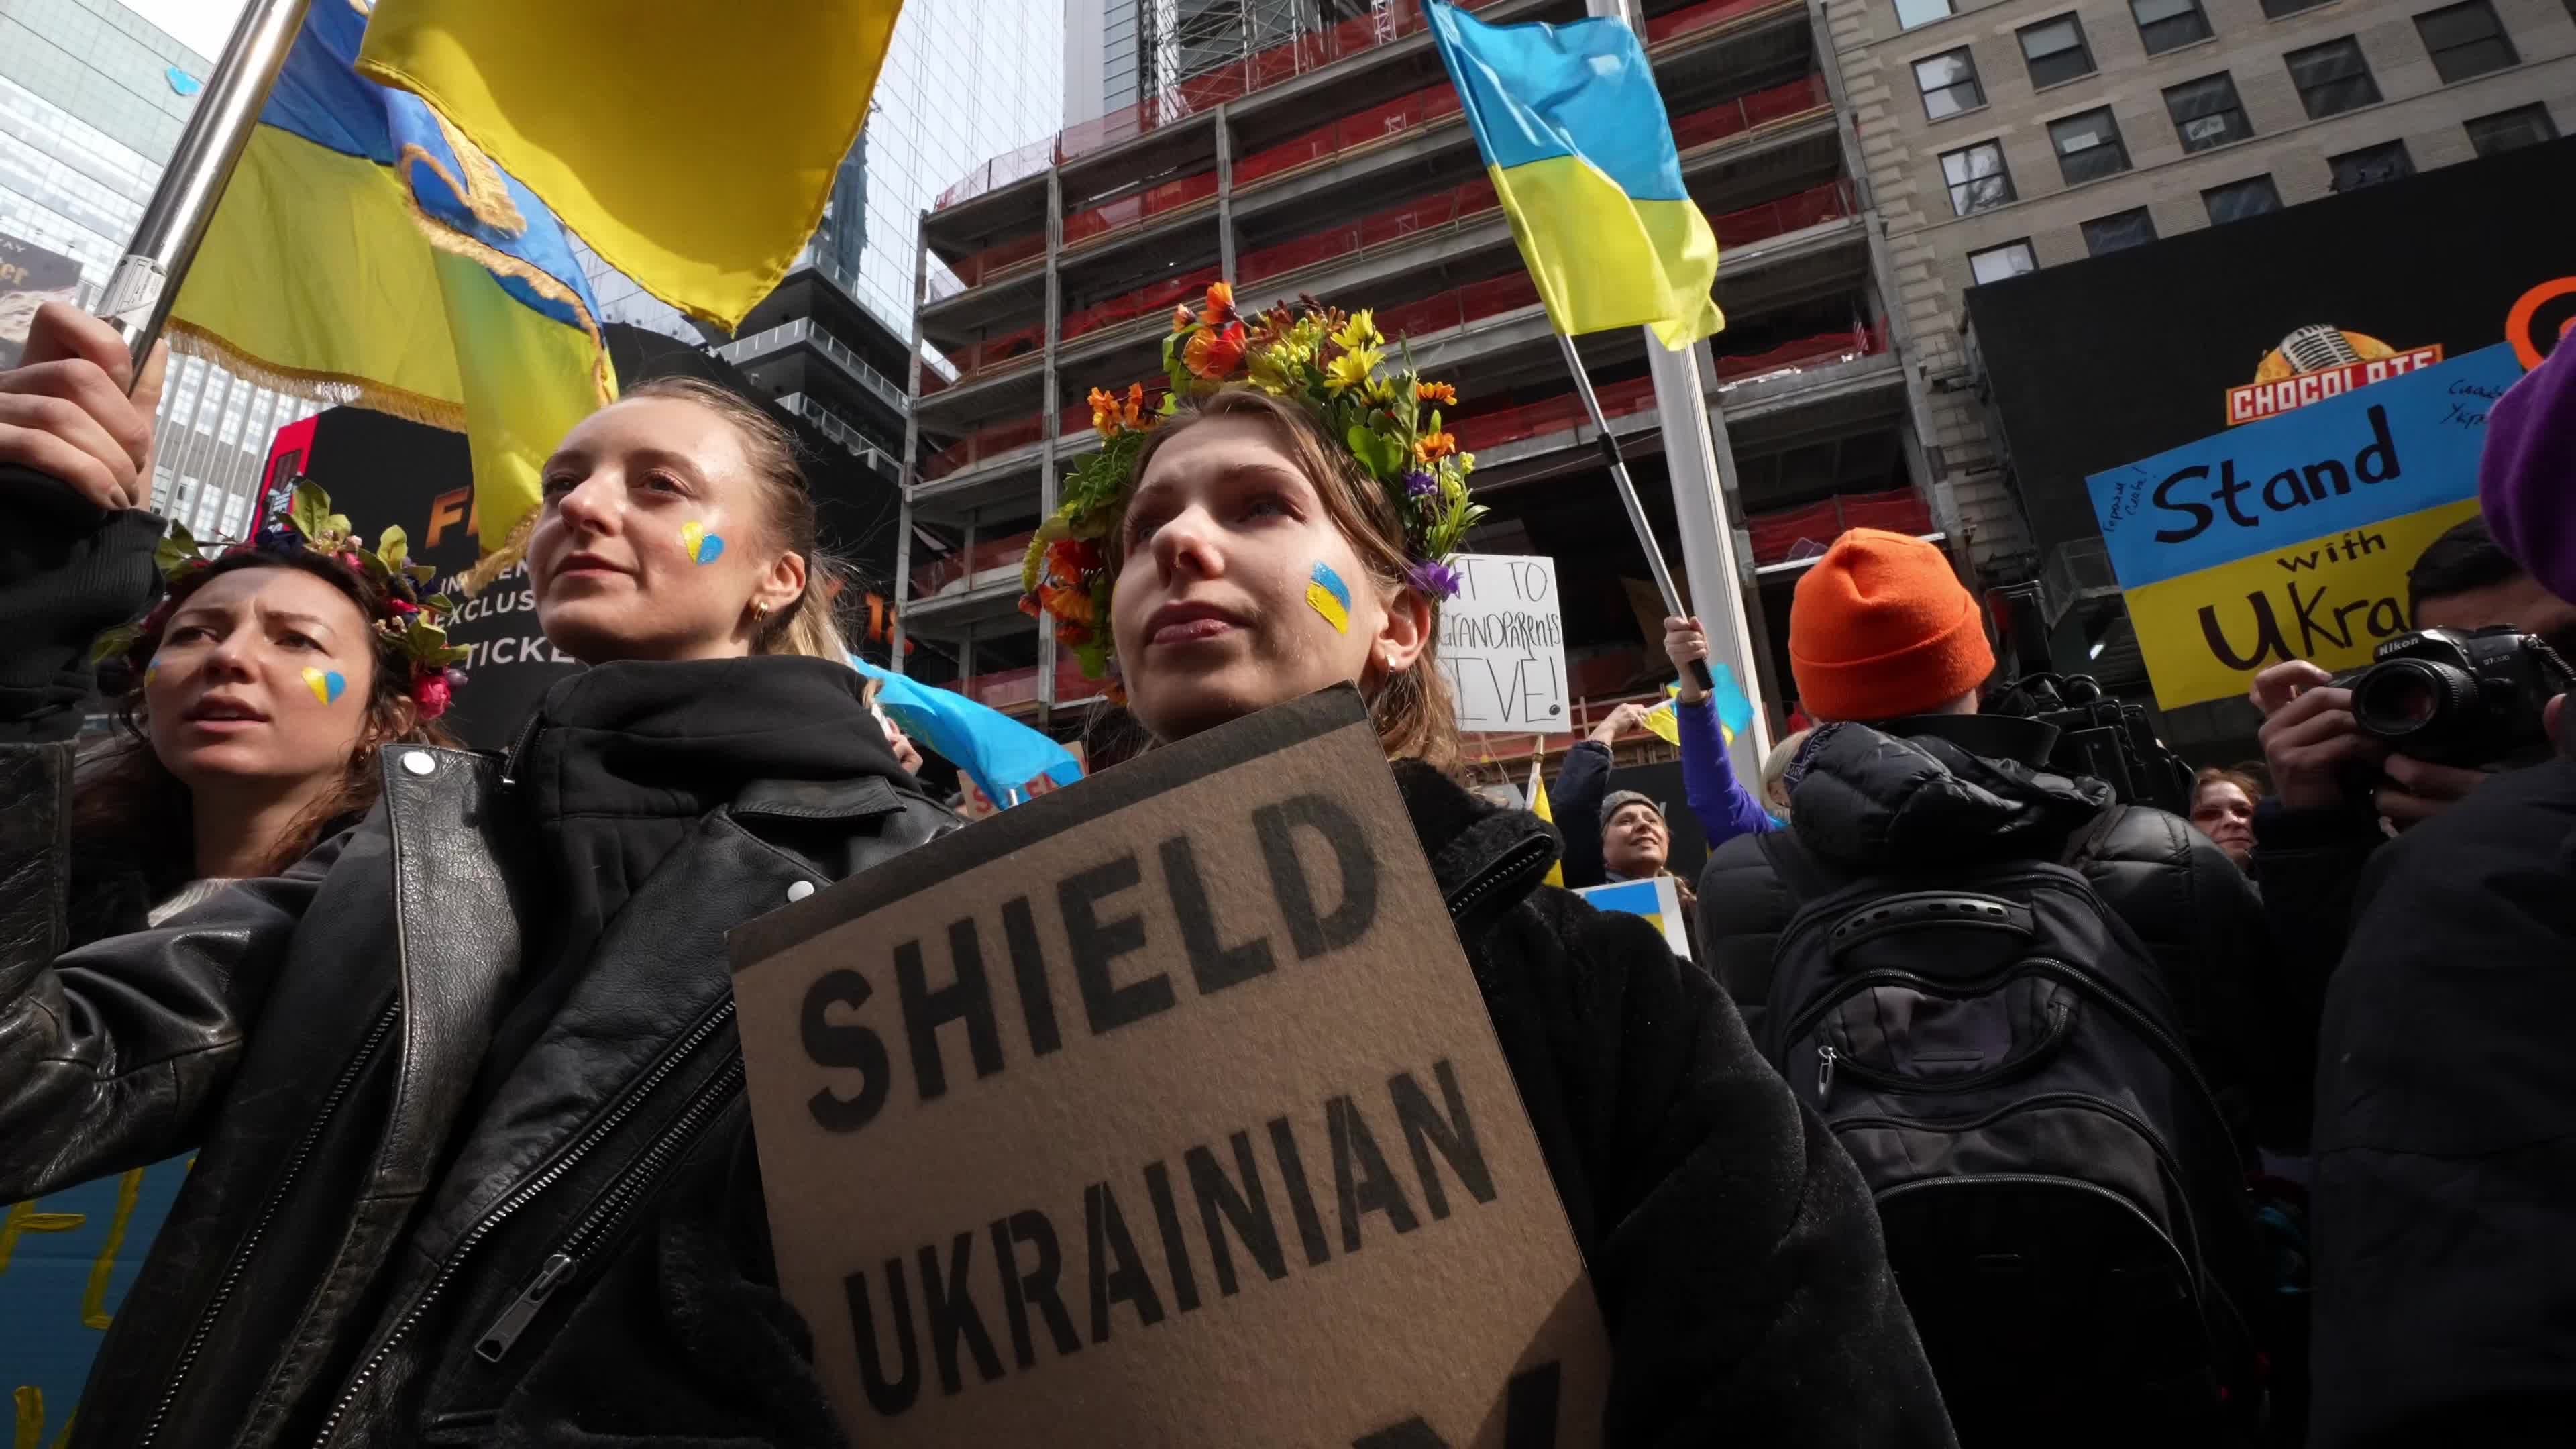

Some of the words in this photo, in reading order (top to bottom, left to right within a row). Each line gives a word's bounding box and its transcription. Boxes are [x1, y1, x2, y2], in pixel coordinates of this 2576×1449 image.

[2152, 404, 2401, 543] Stand
[1503, 561, 1548, 602] TO
[2277, 530, 2387, 573] with
[433, 590, 536, 629] EXCLUS
[2197, 570, 2414, 672] Ukra
[2379, 637, 2420, 656] Nikon
[798, 793, 1379, 1134] SHIELD
[841, 1058, 1499, 1418] UKRAINIAN
